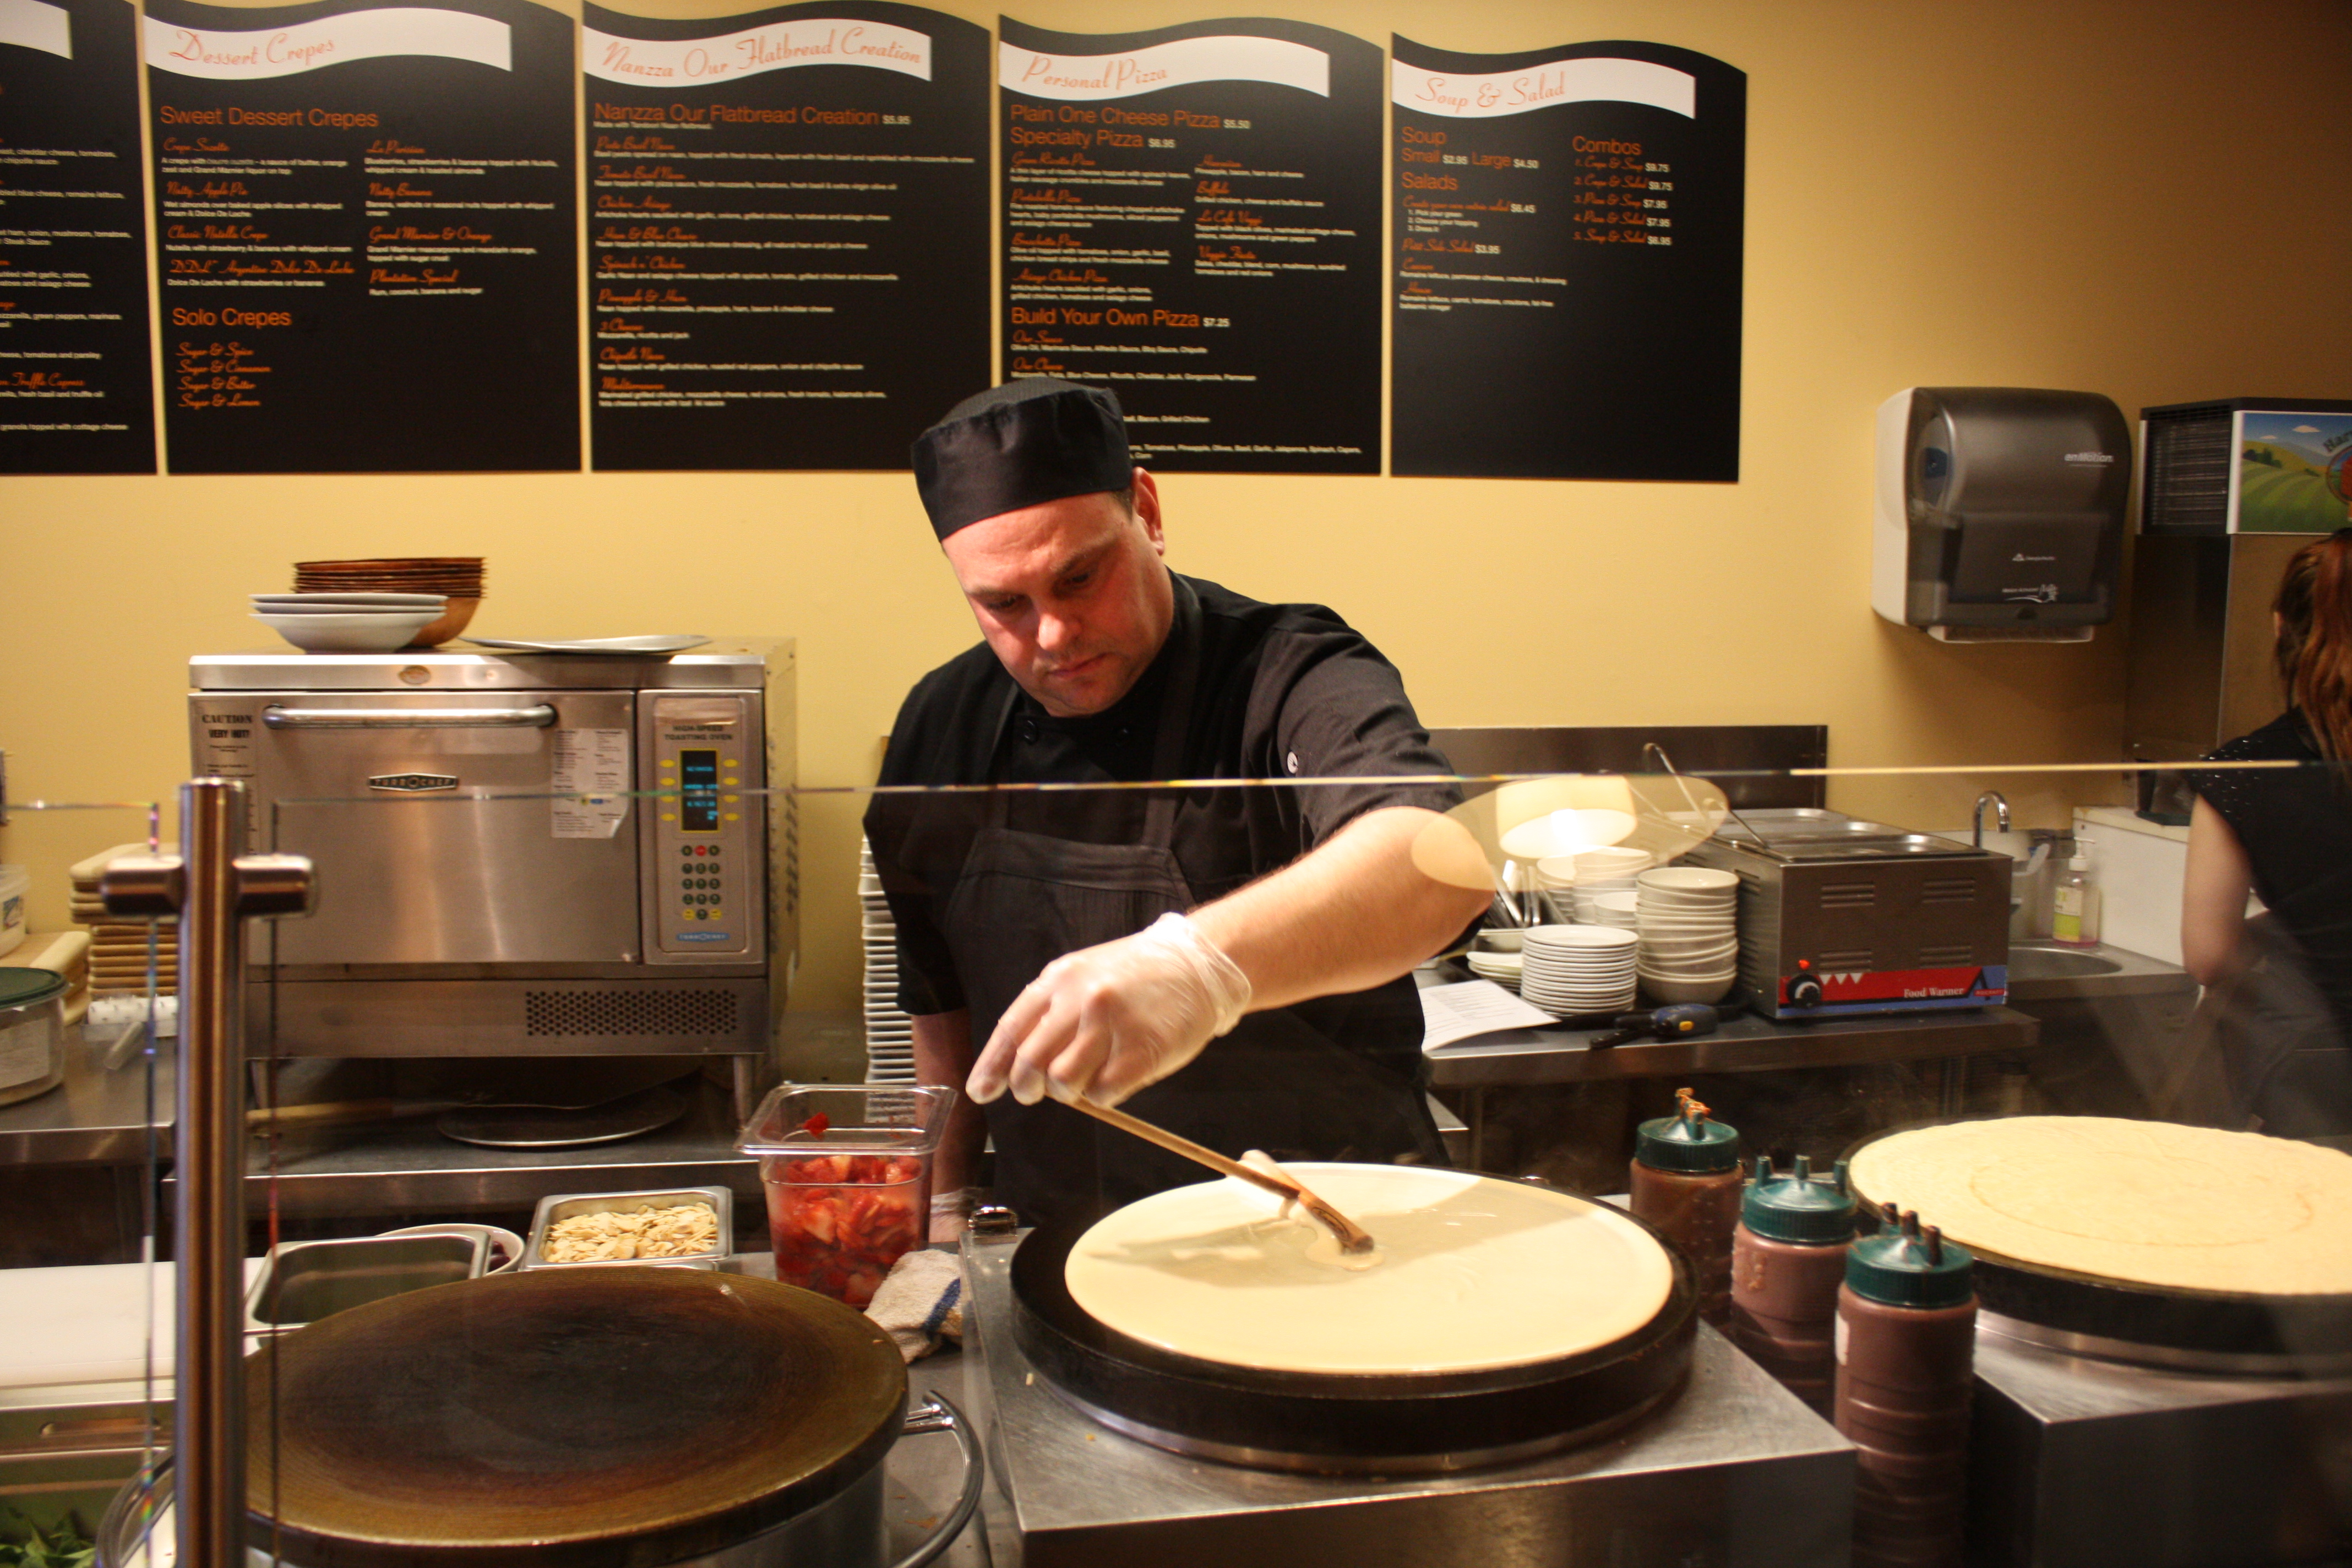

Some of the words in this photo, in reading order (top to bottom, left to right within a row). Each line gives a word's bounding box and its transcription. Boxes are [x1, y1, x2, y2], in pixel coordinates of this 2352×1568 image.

[169, 30, 258, 66] Dessert
[266, 32, 334, 66] Crepes
[602, 41, 674, 78] Nanzza
[683, 48, 728, 77] Our
[735, 29, 835, 70] Flatbread
[841, 26, 921, 63] Creation
[1022, 56, 1114, 88] Personal
[1115, 58, 1168, 90] Pizza
[1415, 77, 1468, 114] Soup
[1477, 83, 1501, 107] &
[1507, 70, 1566, 106] Salad
[160, 106, 224, 125] Sweet
[228, 107, 305, 127] Dessert
[308, 108, 379, 130] Crepes
[594, 102, 665, 121] Nanzza
[669, 104, 706, 121] Our
[710, 104, 798, 123] Flatbread
[801, 106, 880, 126] Creation
[1010, 104, 1054, 122] Plain
[1057, 106, 1098, 124] One
[1100, 106, 1170, 127] Cheese
[1173, 110, 1221, 129] Pizza
[1010, 127, 1092, 150] Specialty
[1096, 129, 1145, 148] Pizza
[1402, 127, 1447, 146] Soup
[1572, 135, 1643, 156] Combos
[1401, 148, 1441, 164] Small
[1471, 151, 1512, 169] Large
[1401, 171, 1459, 190] Salads
[172, 308, 218, 326] Solo
[221, 308, 293, 329] Crepes
[1011, 307, 1059, 325] Build
[1060, 308, 1102, 325] Your
[1105, 308, 1150, 326] Own
[1152, 309, 1201, 327] Pizza
[175, 341, 209, 359] Sugar
[176, 358, 209, 376] Sugar
[177, 375, 210, 393] Sugar
[177, 393, 211, 410] Sugar
[202, 715, 252, 723] CAUTION
[1903, 987, 1926, 998] Food
[1928, 987, 1965, 997] Warmer
